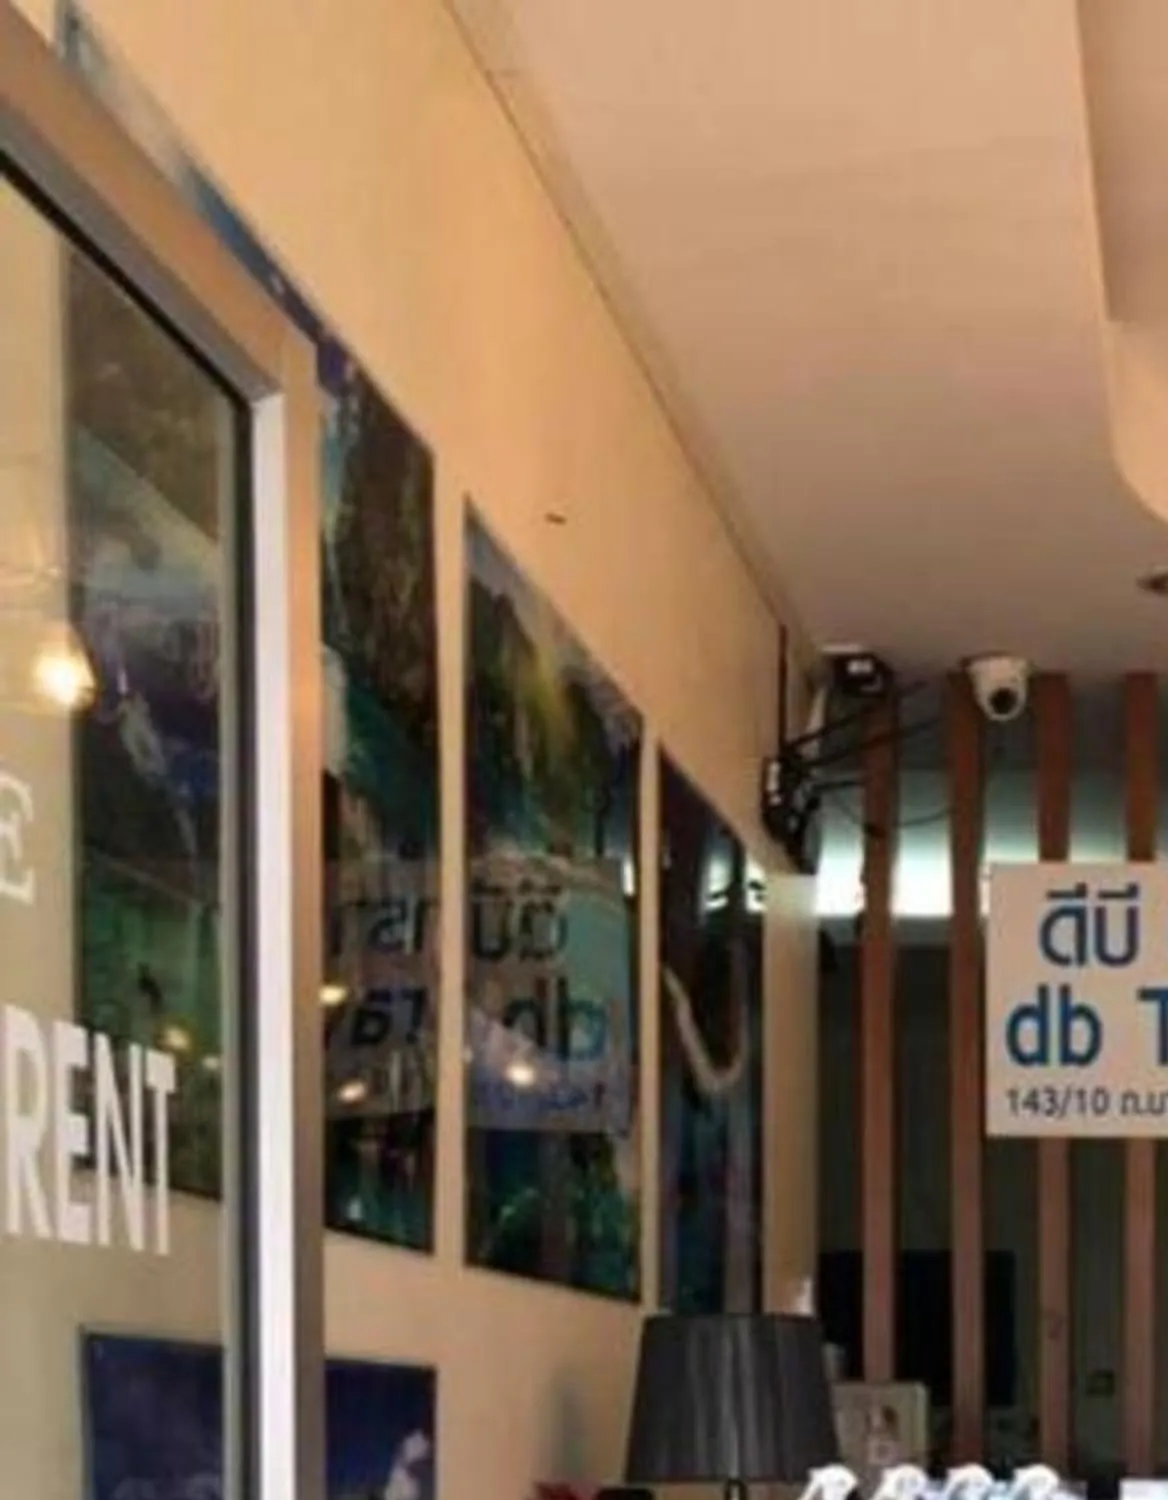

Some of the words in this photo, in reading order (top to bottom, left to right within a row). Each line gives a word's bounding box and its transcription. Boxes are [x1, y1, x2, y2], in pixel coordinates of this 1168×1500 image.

[1038, 884, 1140, 967] ดีบี
[1006, 984, 1102, 1068] db
[4, 1004, 177, 1256] RENT
[1005, 1086, 1110, 1118] 143/10
